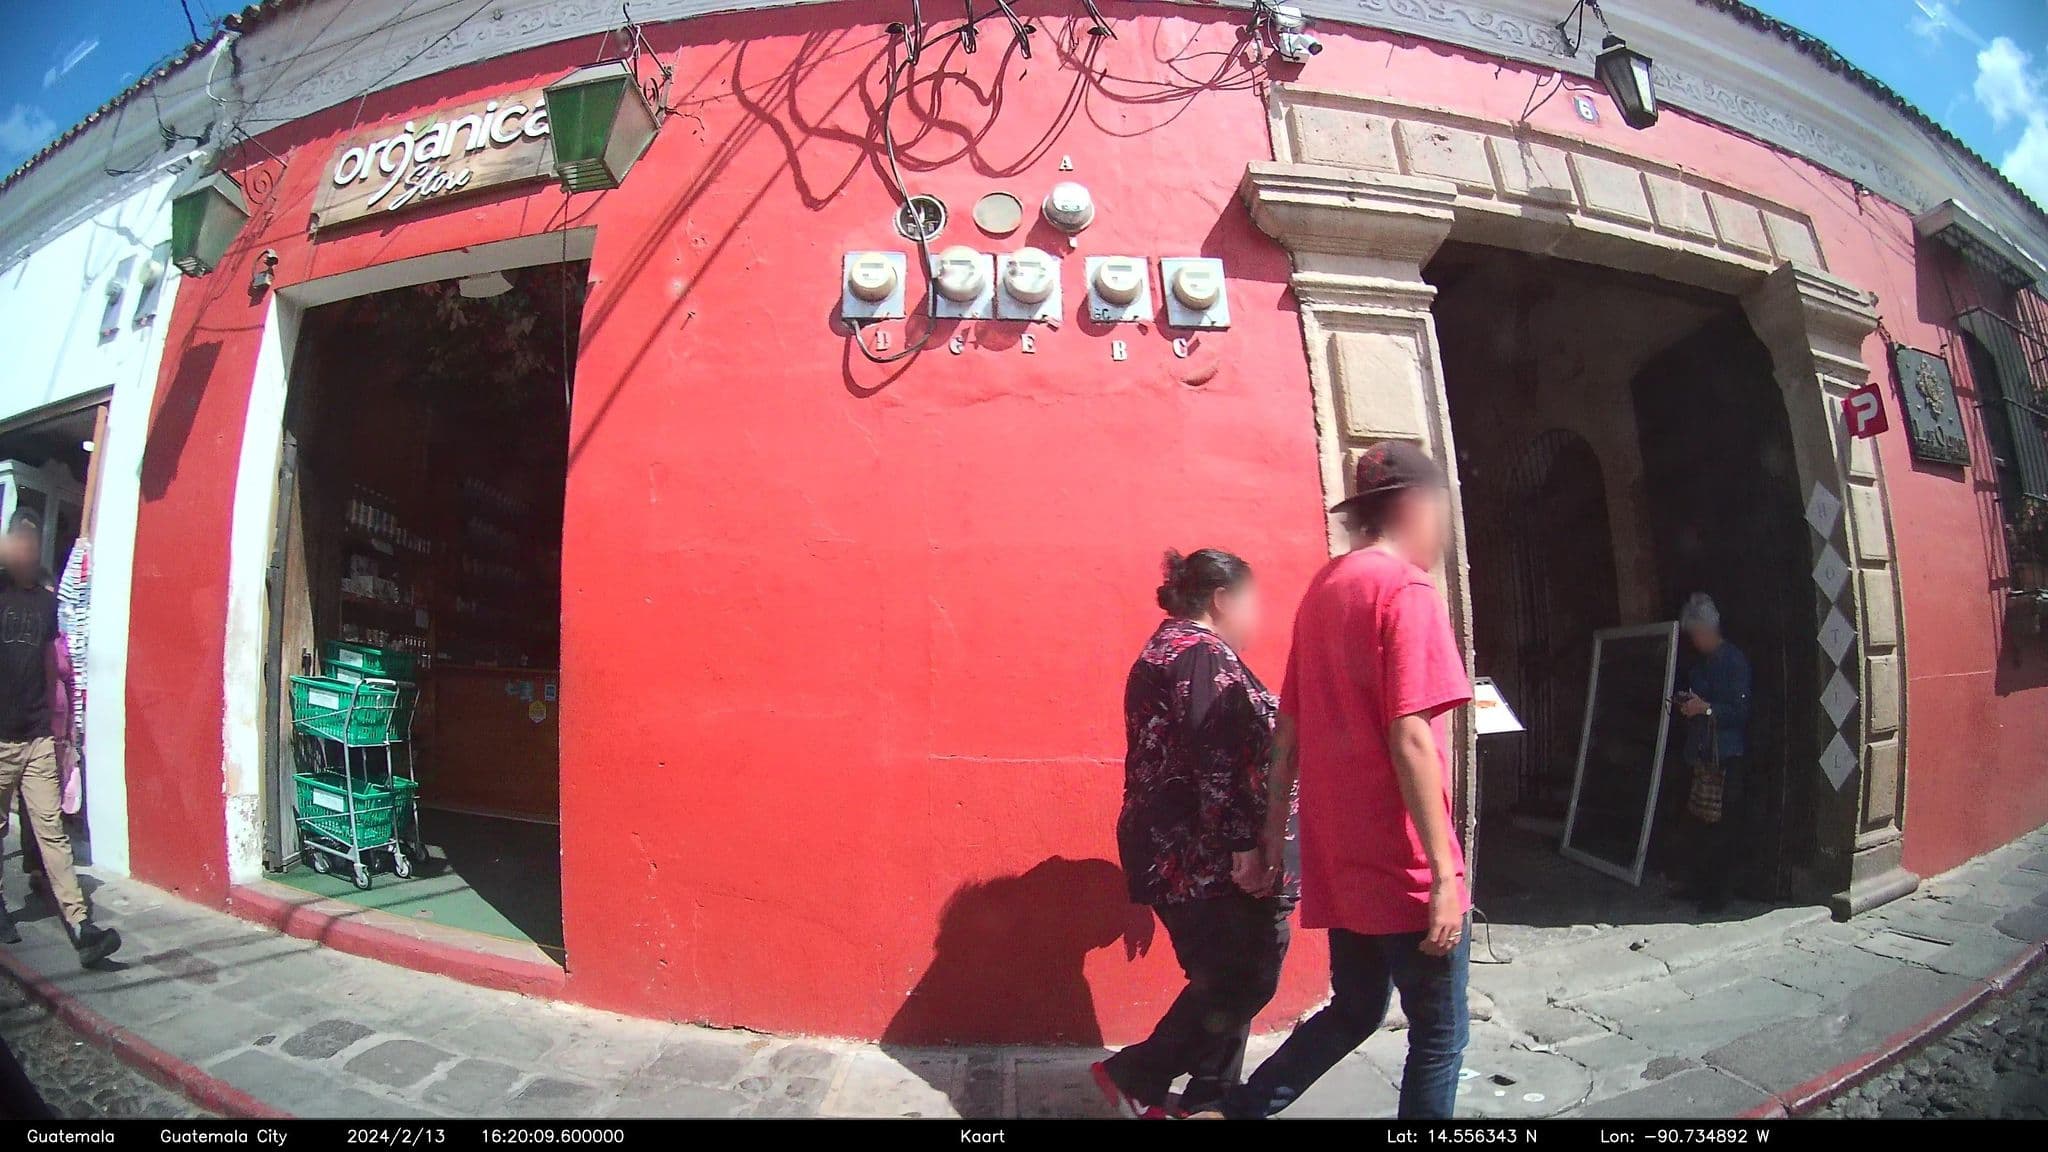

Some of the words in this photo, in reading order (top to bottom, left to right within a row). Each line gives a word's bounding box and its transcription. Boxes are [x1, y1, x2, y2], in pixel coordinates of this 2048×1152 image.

[1578, 99, 1594, 120] 6
[1059, 155, 1073, 171] A
[388, 165, 471, 211] Store
[1112, 340, 1127, 361] B
[1851, 392, 1878, 432] P
